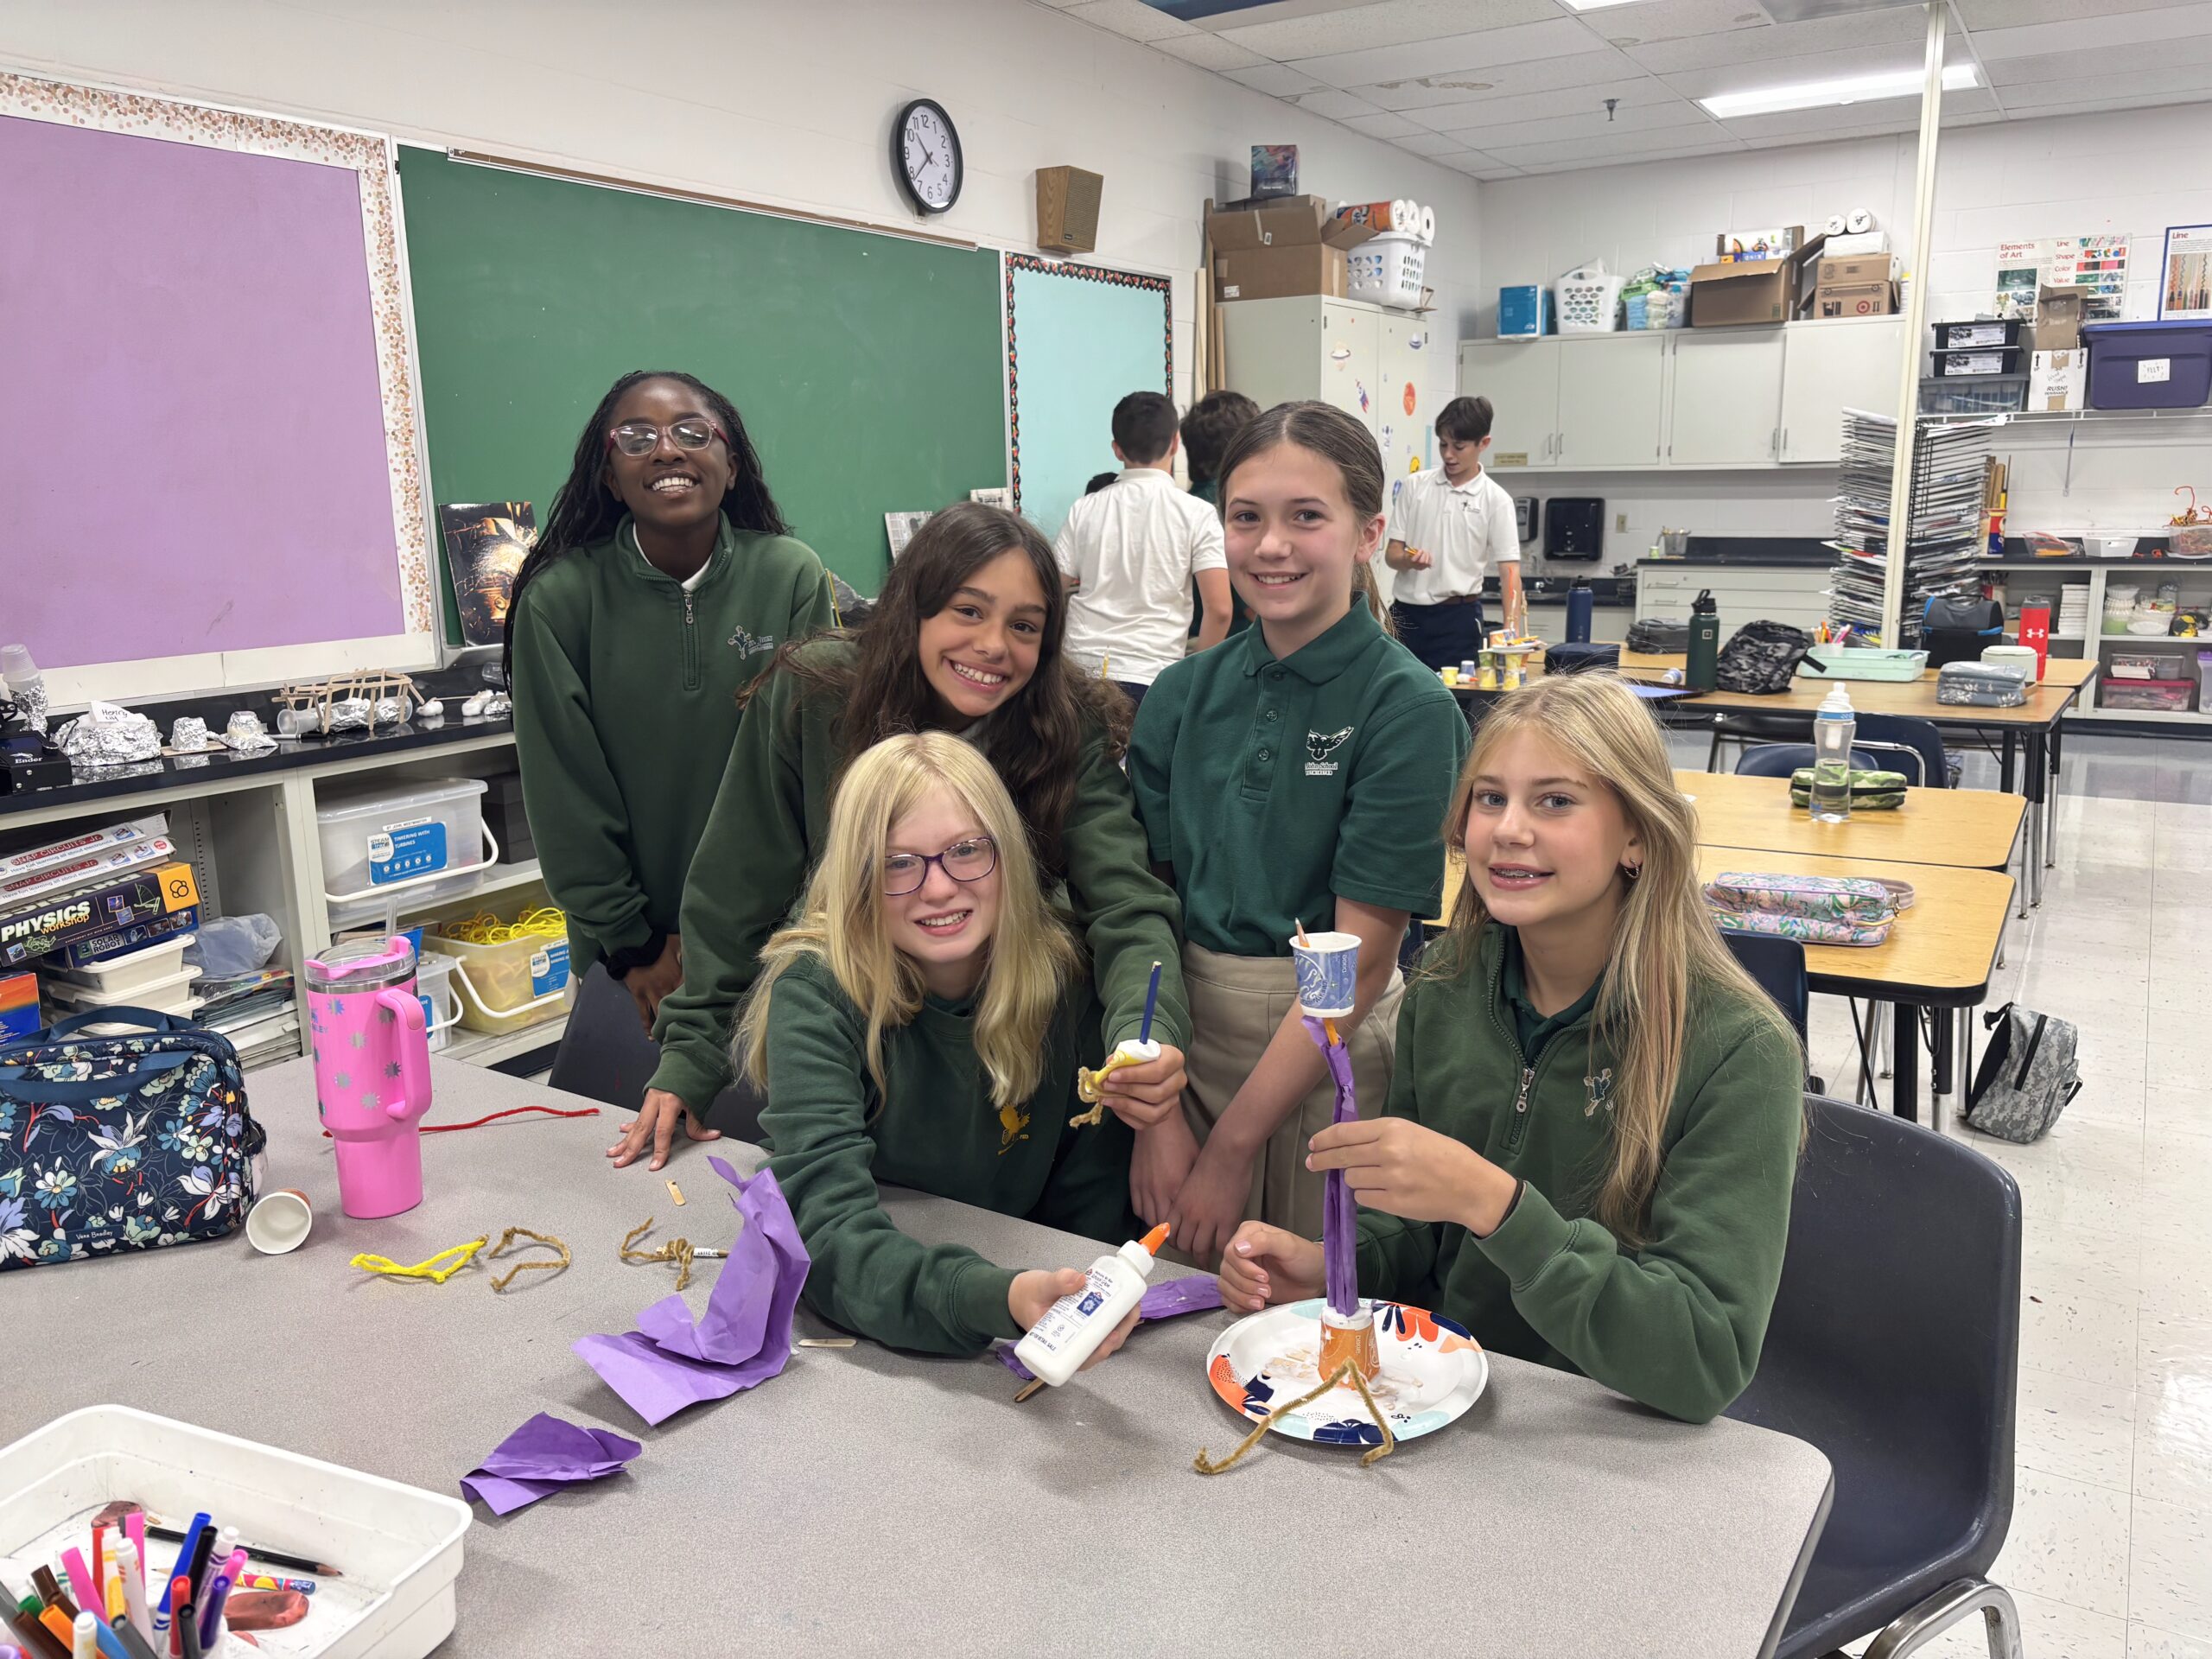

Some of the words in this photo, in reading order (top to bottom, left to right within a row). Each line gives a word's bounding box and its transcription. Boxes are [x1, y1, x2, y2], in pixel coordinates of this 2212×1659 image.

[912, 116, 919, 130] 11
[921, 114, 930, 129] 12
[932, 121, 938, 134] 1
[906, 128, 915, 143] 10
[941, 136, 947, 149] 2
[904, 146, 910, 160] 9
[944, 154, 951, 168] 3
[909, 166, 915, 180] 8
[942, 174, 949, 186] 4
[917, 180, 924, 194] 7
[927, 186, 934, 200] 6
[937, 183, 943, 197] 5
[1999, 243, 2036, 251] Elements
[2010, 251, 2024, 259] Art
[101, 709, 128, 719] Henry
[394, 832, 417, 842] TINKERING
[394, 839, 416, 849] TURBINES
[10, 852, 39, 866] SNAP
[40, 838, 86, 857] CIRCUITS
[35, 855, 60, 865] learning
[67, 847, 84, 856] about
[3, 879, 32, 892] SNAP
[34, 863, 81, 882] CIRCUITS
[29, 881, 54, 893] learning
[61, 873, 79, 881] about
[1, 900, 91, 943] PHYSICS
[41, 913, 90, 935] workshop
[92, 933, 119, 947] SOLAR
[93, 940, 122, 953] ROBOT
[91, 1229, 113, 1239] Bradley
